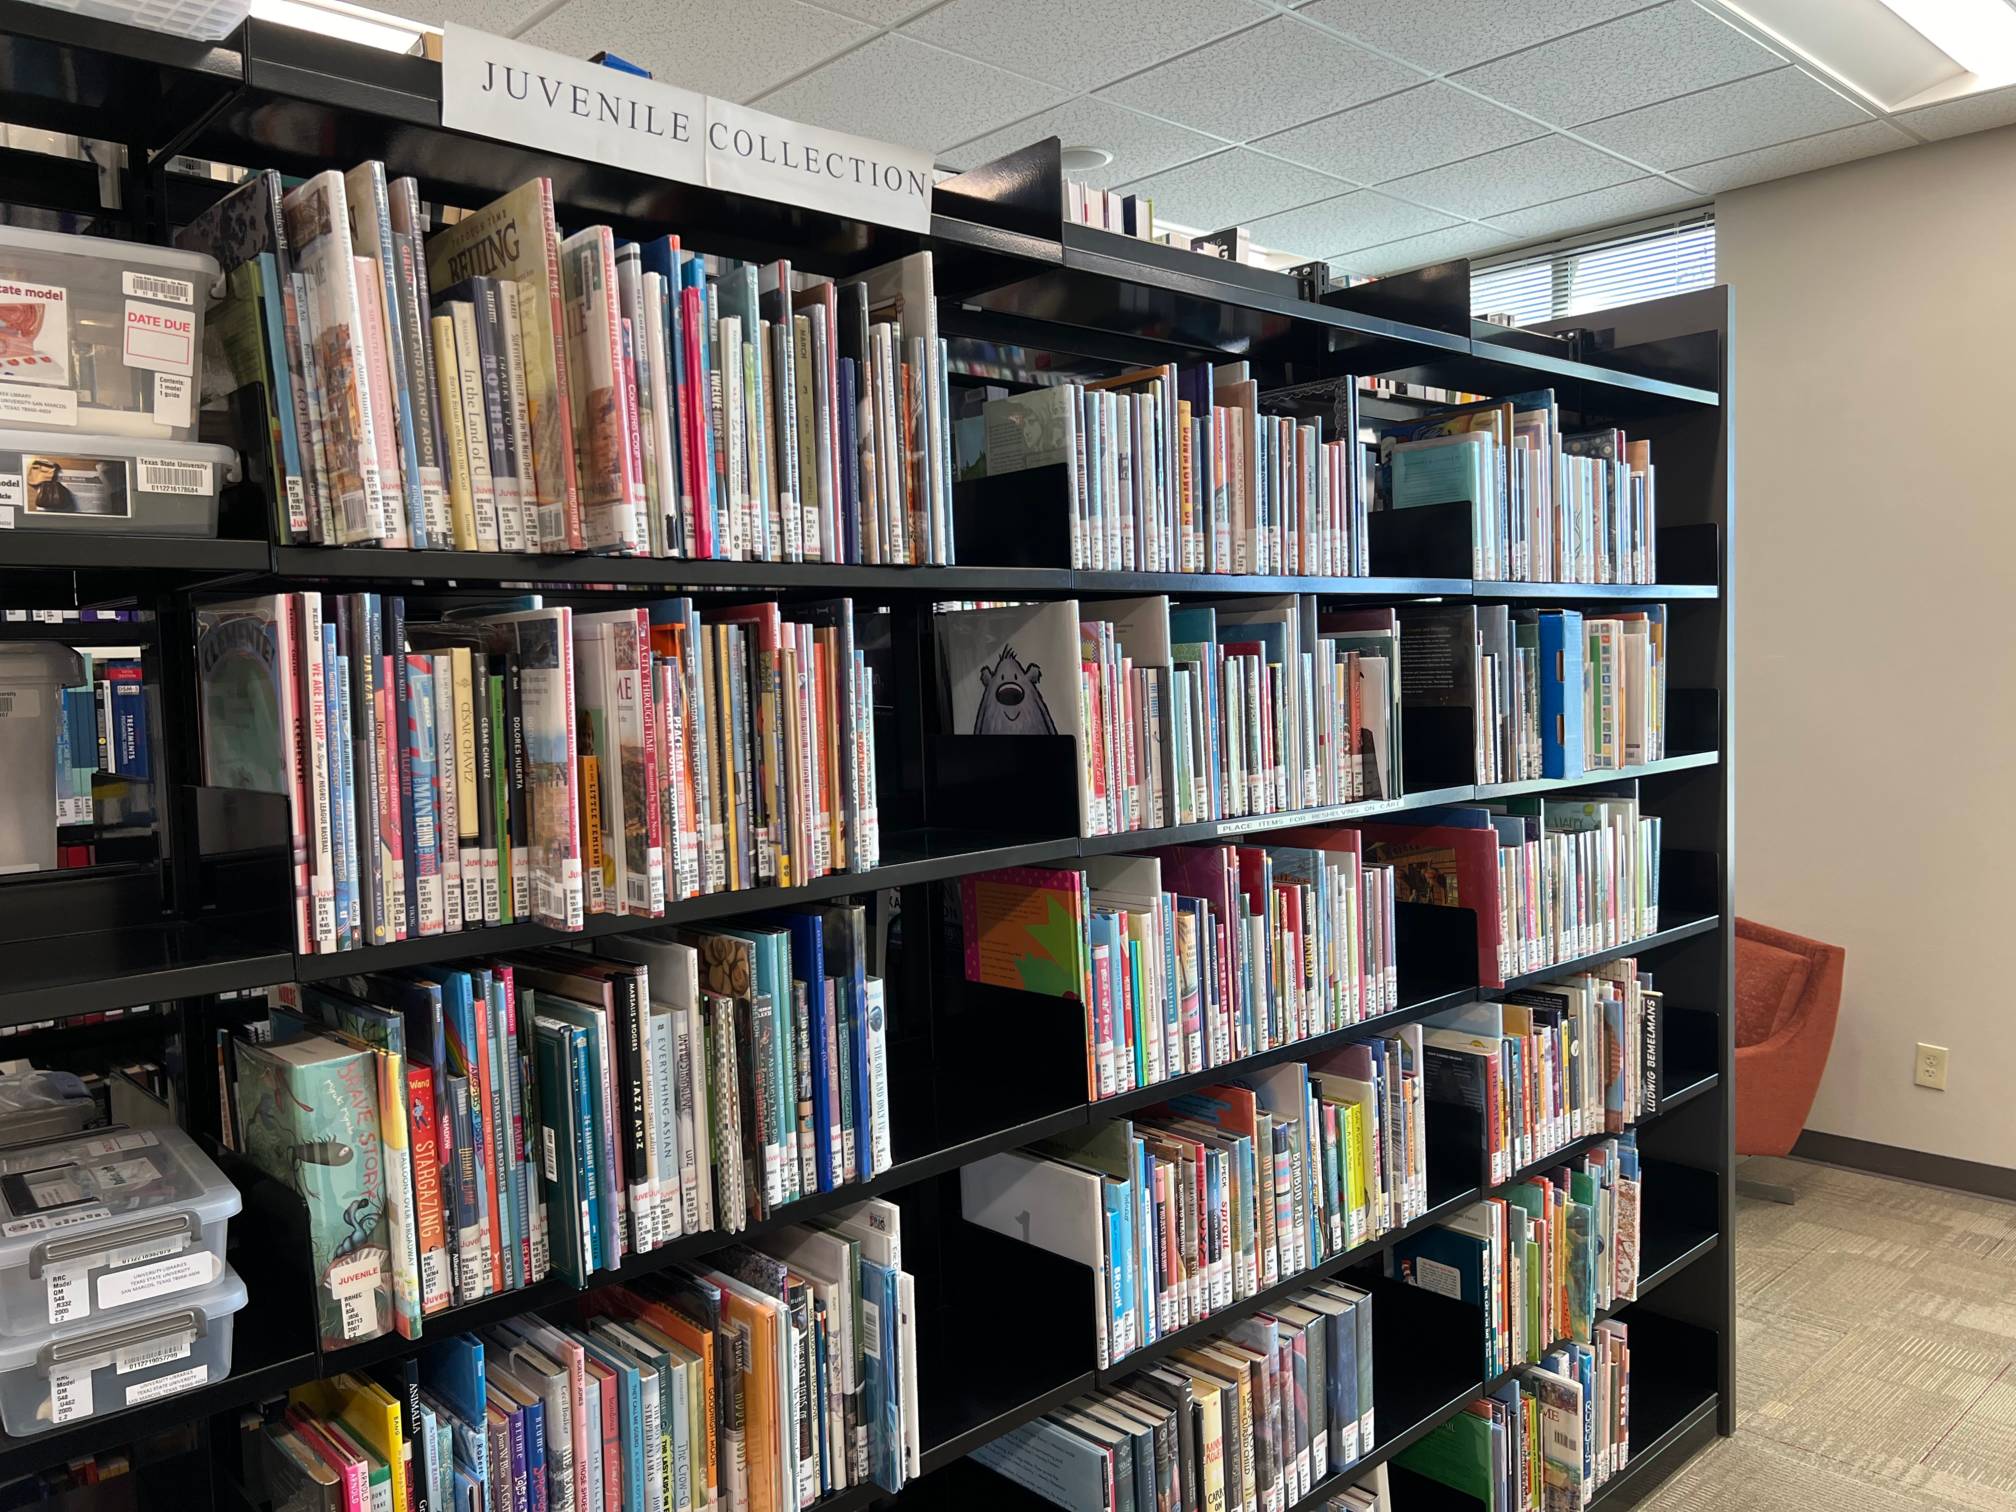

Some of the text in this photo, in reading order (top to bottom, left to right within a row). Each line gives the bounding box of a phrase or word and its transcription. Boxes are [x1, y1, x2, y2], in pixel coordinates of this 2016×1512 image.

[482, 60, 927, 199] JUVENILE COLLECTION
[25, 288, 64, 302] model
[128, 311, 191, 333] DATE DUE
[401, 244, 428, 423] GIBLIN THE LIFE AND DEATH OF
[485, 354, 505, 453] MOTHER
[709, 369, 723, 409] TWELVE
[297, 387, 311, 444] GOLEM
[465, 369, 483, 464] In the Land of
[628, 383, 641, 459] COUNTING COUP
[140, 458, 208, 471] Texas State University
[641, 652, 650, 675] CITY
[643, 678, 653, 728] THROUGH
[312, 607, 329, 854] NELSON WE ARE THE SHIP NEGRO LEAGUE BASEBALL
[481, 717, 491, 779] CESAR CHAVEZ
[645, 729, 654, 753] TIME
[513, 716, 523, 789] DOLORES HUERTA
[378, 748, 390, 815] Born to Dance
[400, 747, 412, 797] TALLCHIEF
[415, 784, 435, 847] MAN BEHIND
[443, 733, 457, 863] SIX DAYS IN OCTOBER
[590, 783, 599, 820] LITTLE
[1222, 822, 1253, 833] PLACE
[1258, 818, 1284, 828] ITEMS
[1289, 815, 1307, 824] FOR
[1311, 808, 1355, 820] RESHELVING
[1379, 801, 1402, 809] CART
[629, 983, 637, 1017] MARSALIS
[633, 1079, 644, 1112] JAZZ
[1646, 999, 1657, 1112] LUDWIG BEMELMANS
[410, 1079, 430, 1090] Wang
[658, 1036, 673, 1160] EVERYTHING ASIAN
[874, 1044, 886, 1120] THE ONE AND ONLY
[442, 1115, 452, 1150] SHADOW
[491, 1092, 507, 1192] JORGE LUIS BORGES
[514, 1122, 523, 1155] PABLO
[358, 1132, 380, 1200] STORY
[685, 1149, 694, 1167] LUTZ
[1263, 1156, 1272, 1193] OUT OF
[415, 1140, 440, 1238] STARGAZING
[1293, 1152, 1303, 1202] BAMBOO
[399, 1151, 415, 1267] BALLOONS OVER BROADWAY
[1221, 1200, 1230, 1249] sprout
[53, 1274, 66, 1282] RRC
[54, 1281, 72, 1289] Model
[338, 1266, 379, 1286] JUVENILE
[452, 1253, 460, 1287] Atheneum
[1114, 1265, 1122, 1308] BROWN
[54, 1288, 64, 1296] QM
[55, 1308, 69, 1316] 2005
[347, 1325, 360, 1333] 2007
[56, 1380, 75, 1388] Model
[57, 1387, 67, 1395] QM
[58, 1406, 72, 1415] 2005
[409, 1382, 421, 1435] ANIMALIA
[645, 1403, 655, 1482] STRIPED PAJAMAS
[677, 1440, 688, 1461] The
[1242, 1417, 1250, 1448] CURSED
[476, 1443, 484, 1476] Robert
[497, 1431, 510, 1491] Joan Blos A
[580, 1460, 588, 1485] THOSE
[350, 1473, 359, 1504] ARNOLD
[361, 1471, 369, 1502] ARNOLD
[515, 1471, 527, 1496] Tales
[1214, 1500, 1224, 1512] ON
